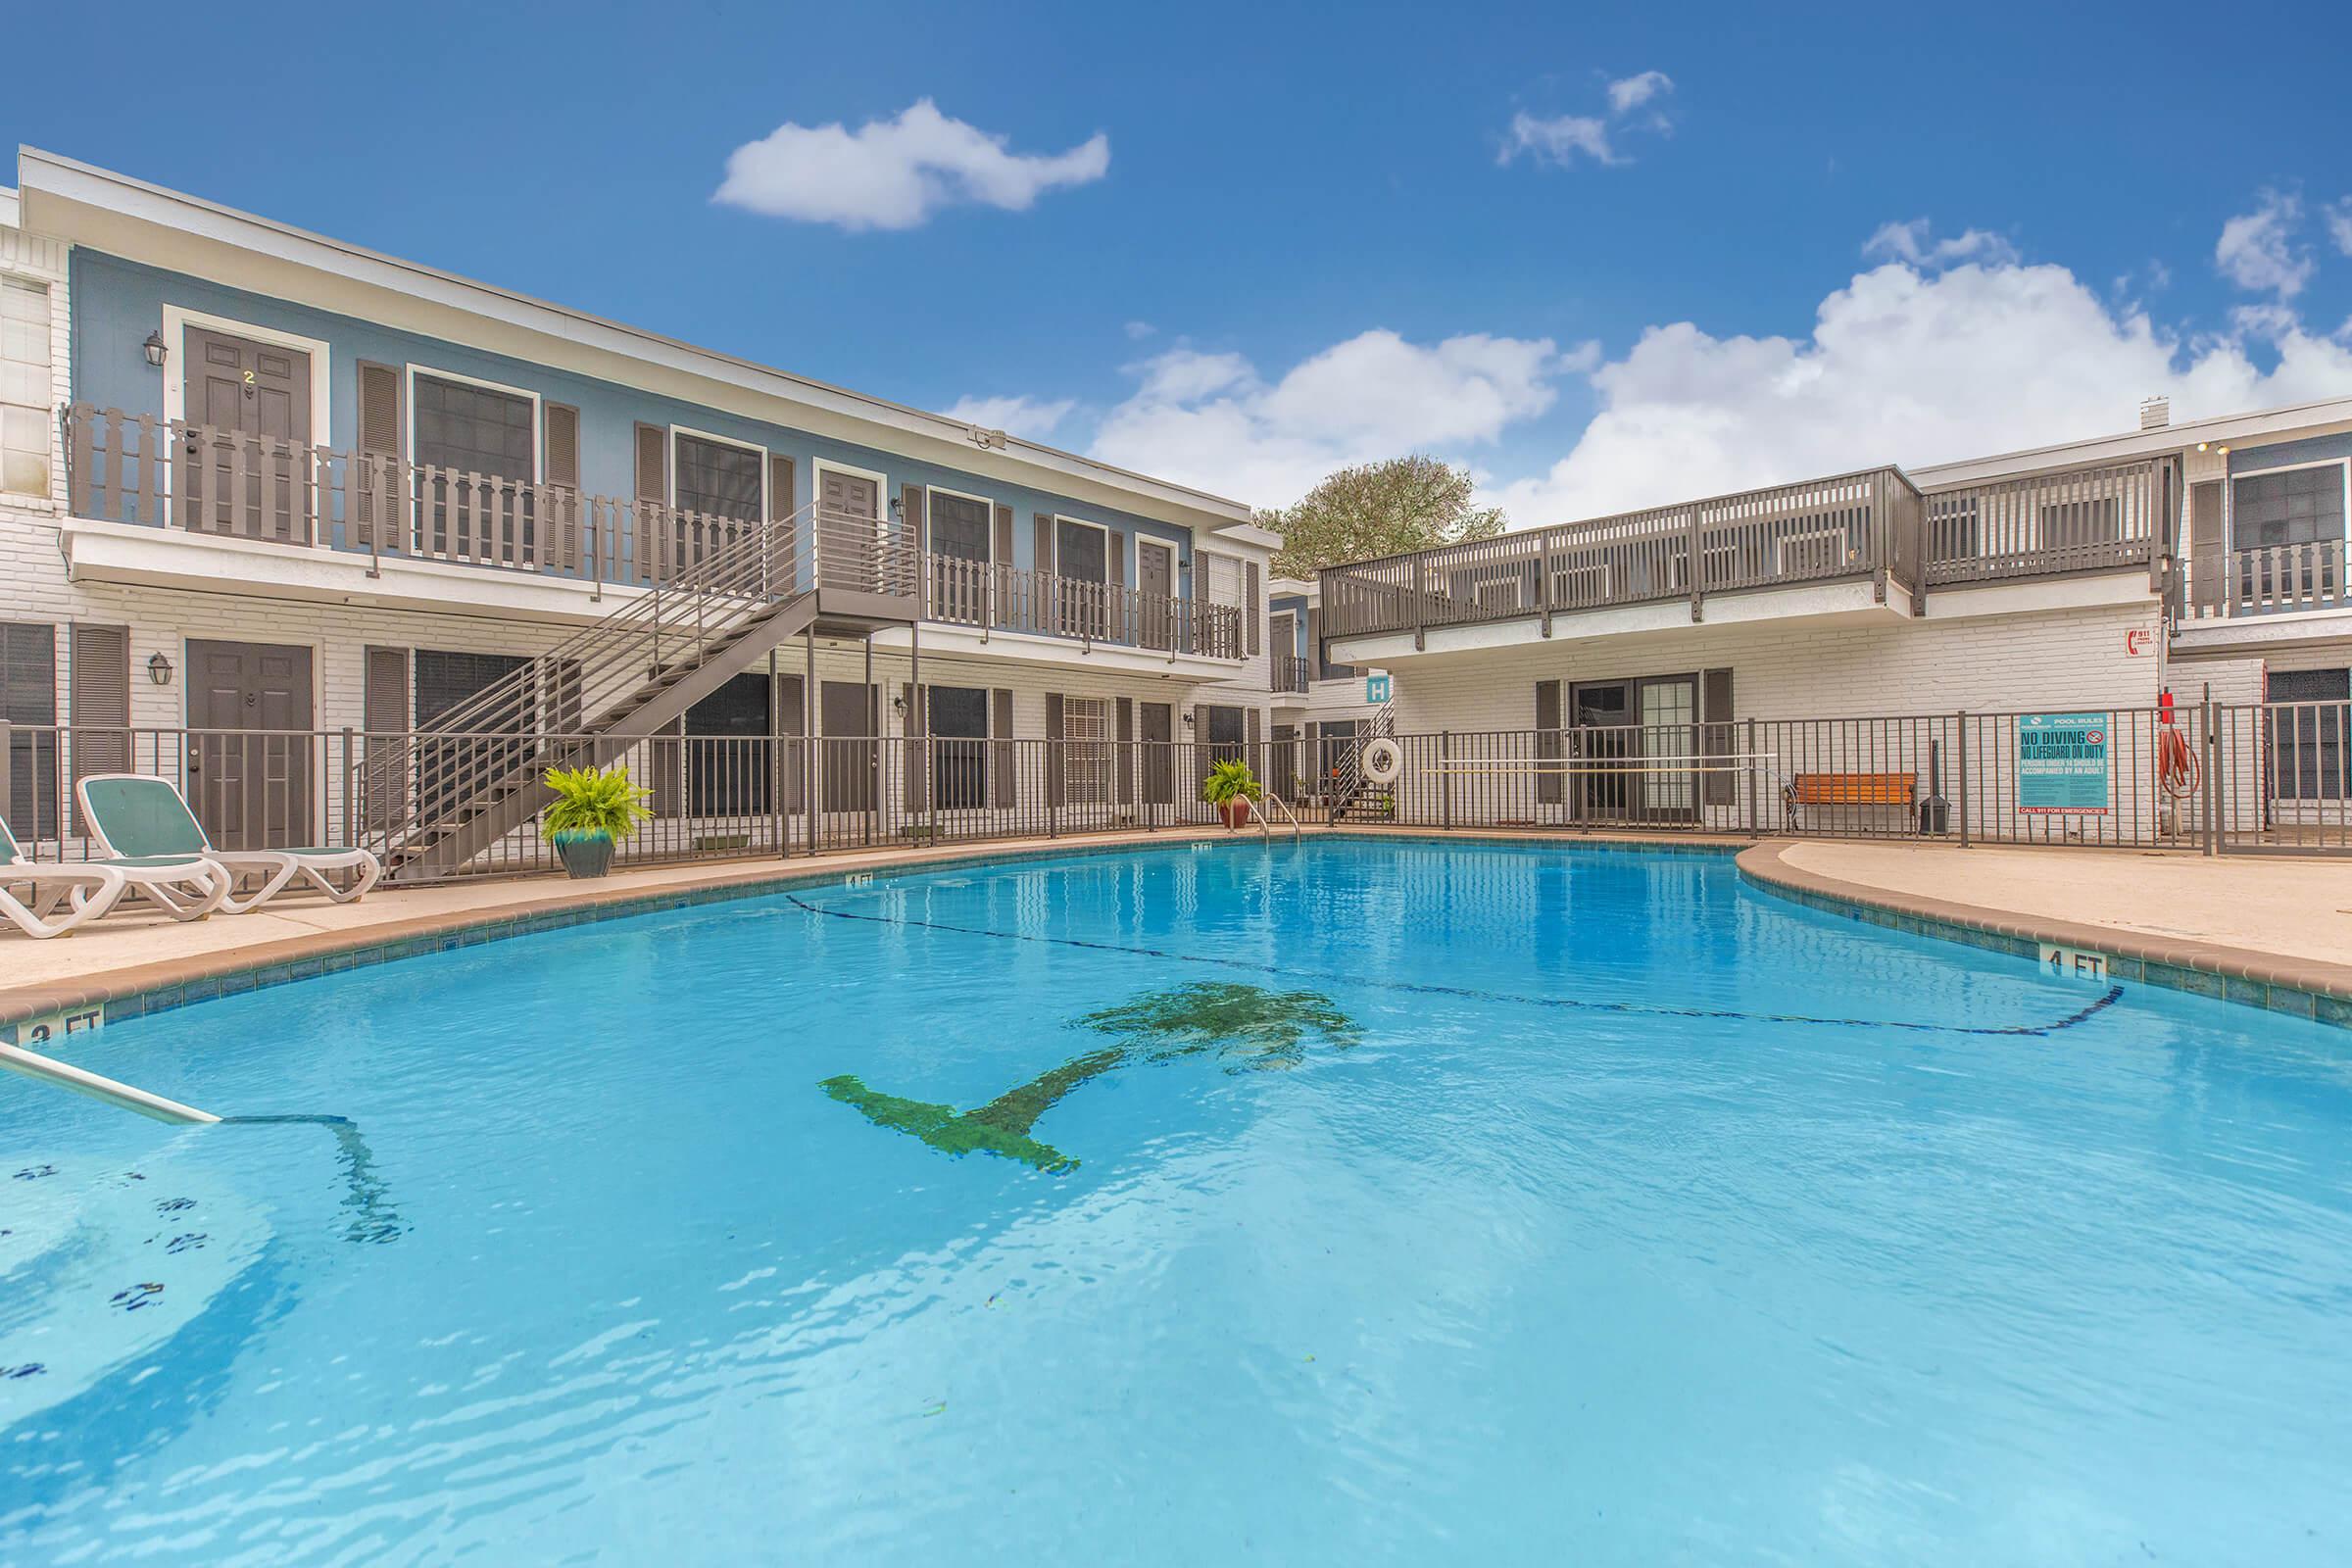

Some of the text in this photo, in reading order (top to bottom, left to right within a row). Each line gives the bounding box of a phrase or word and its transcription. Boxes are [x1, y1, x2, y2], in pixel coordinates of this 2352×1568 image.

[244, 370, 255, 383] 2
[1372, 683, 1384, 700] H
[2021, 731, 2084, 745] NO DIVING
[2021, 745, 2104, 760] NO LIFEGUARD ON DUTY
[2074, 954, 2103, 973] FT
